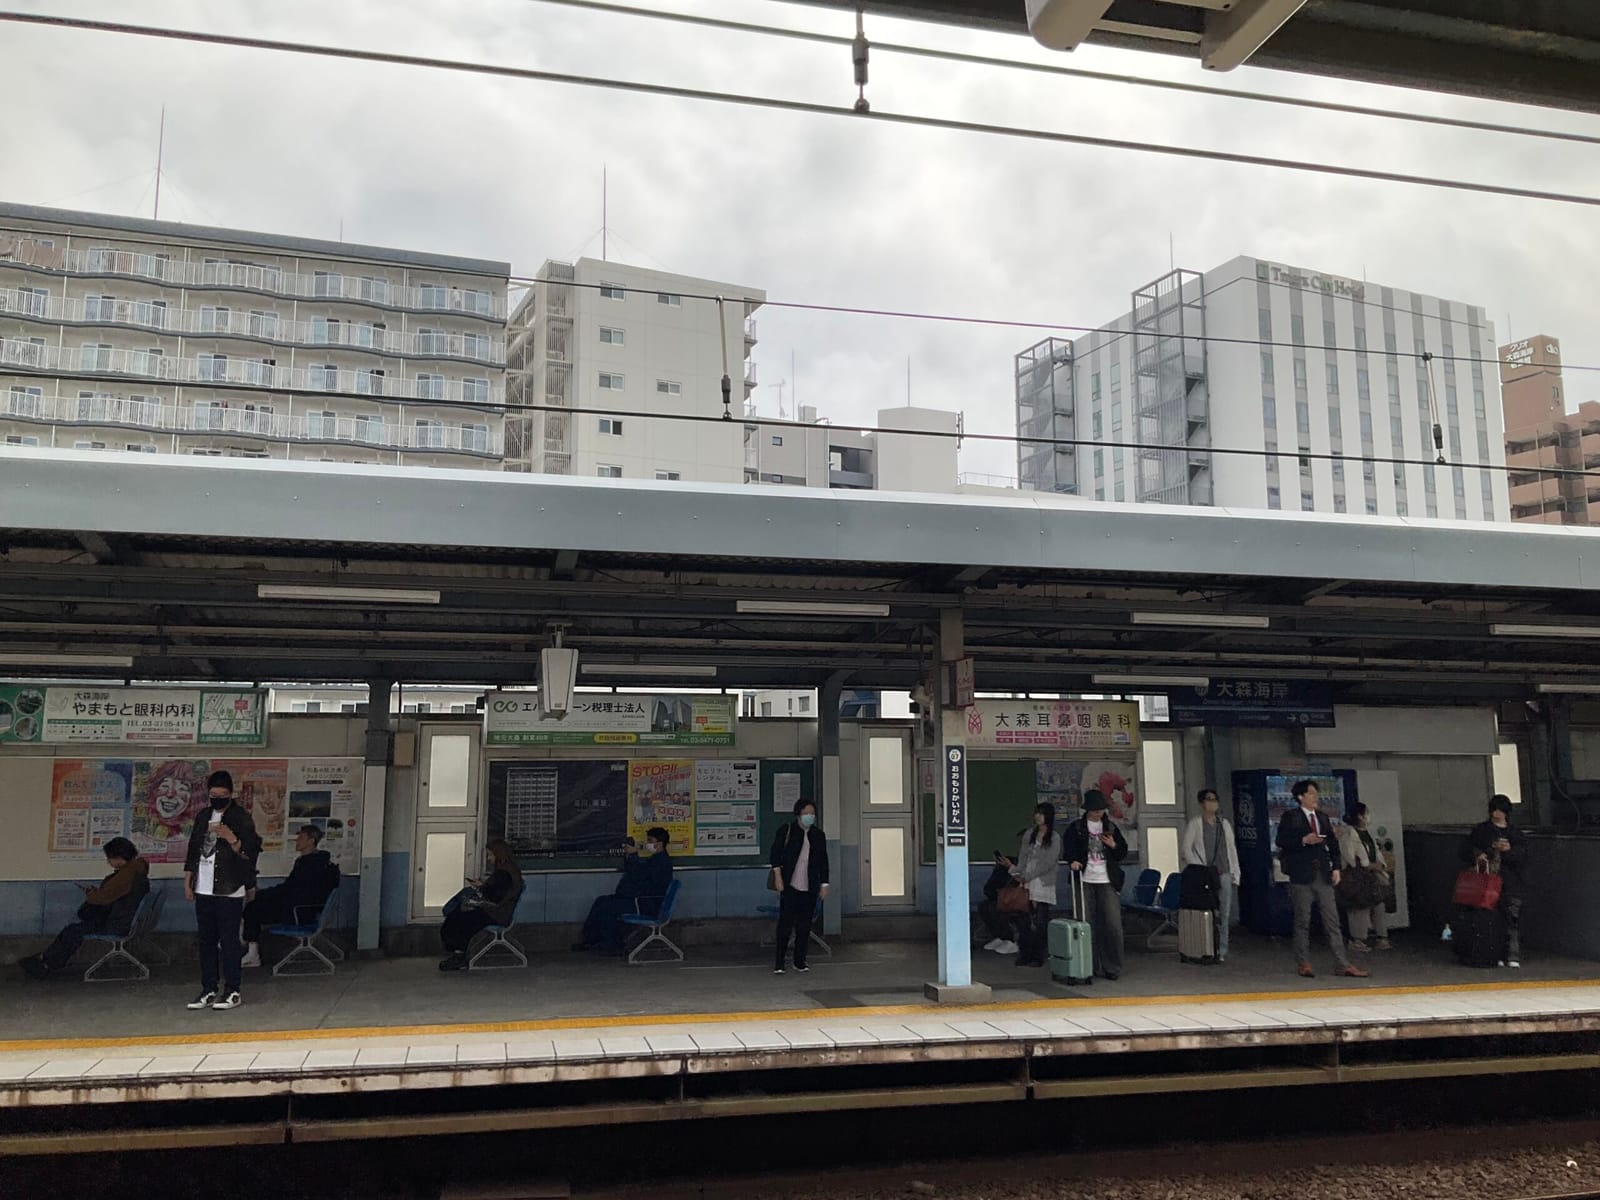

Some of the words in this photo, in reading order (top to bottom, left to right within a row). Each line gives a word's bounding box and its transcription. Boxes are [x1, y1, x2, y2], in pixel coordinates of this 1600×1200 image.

[1216, 681, 1289, 698] 大森海岸
[72, 702, 195, 718] やまもと眼科内科
[995, 712, 1131, 728] 大森耳鼻咽喉科
[632, 763, 677, 777] STOP!!
[951, 765, 960, 824] おおもりかいがん
